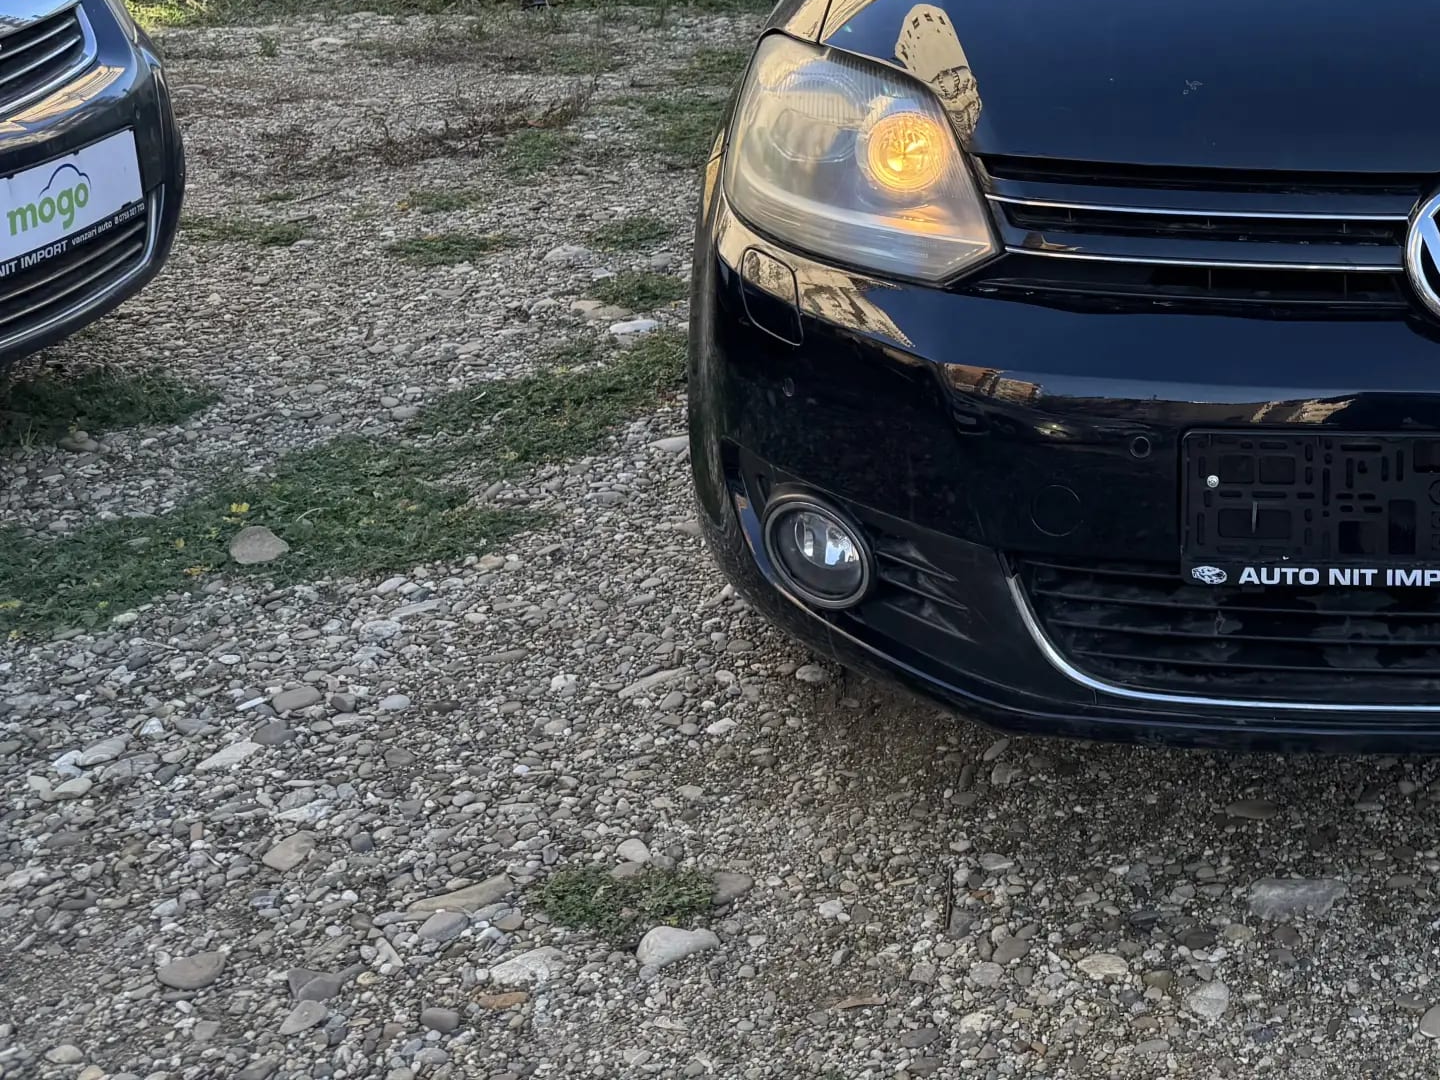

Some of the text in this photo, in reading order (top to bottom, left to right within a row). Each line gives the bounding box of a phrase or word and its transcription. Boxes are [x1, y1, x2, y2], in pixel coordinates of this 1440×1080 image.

[6, 182, 90, 236] mogo
[20, 239, 68, 269] IMPORT
[71, 225, 97, 245] vanzari
[97, 220, 113, 233] auto
[1238, 567, 1320, 585] AUTO
[1328, 568, 1379, 586] NIT
